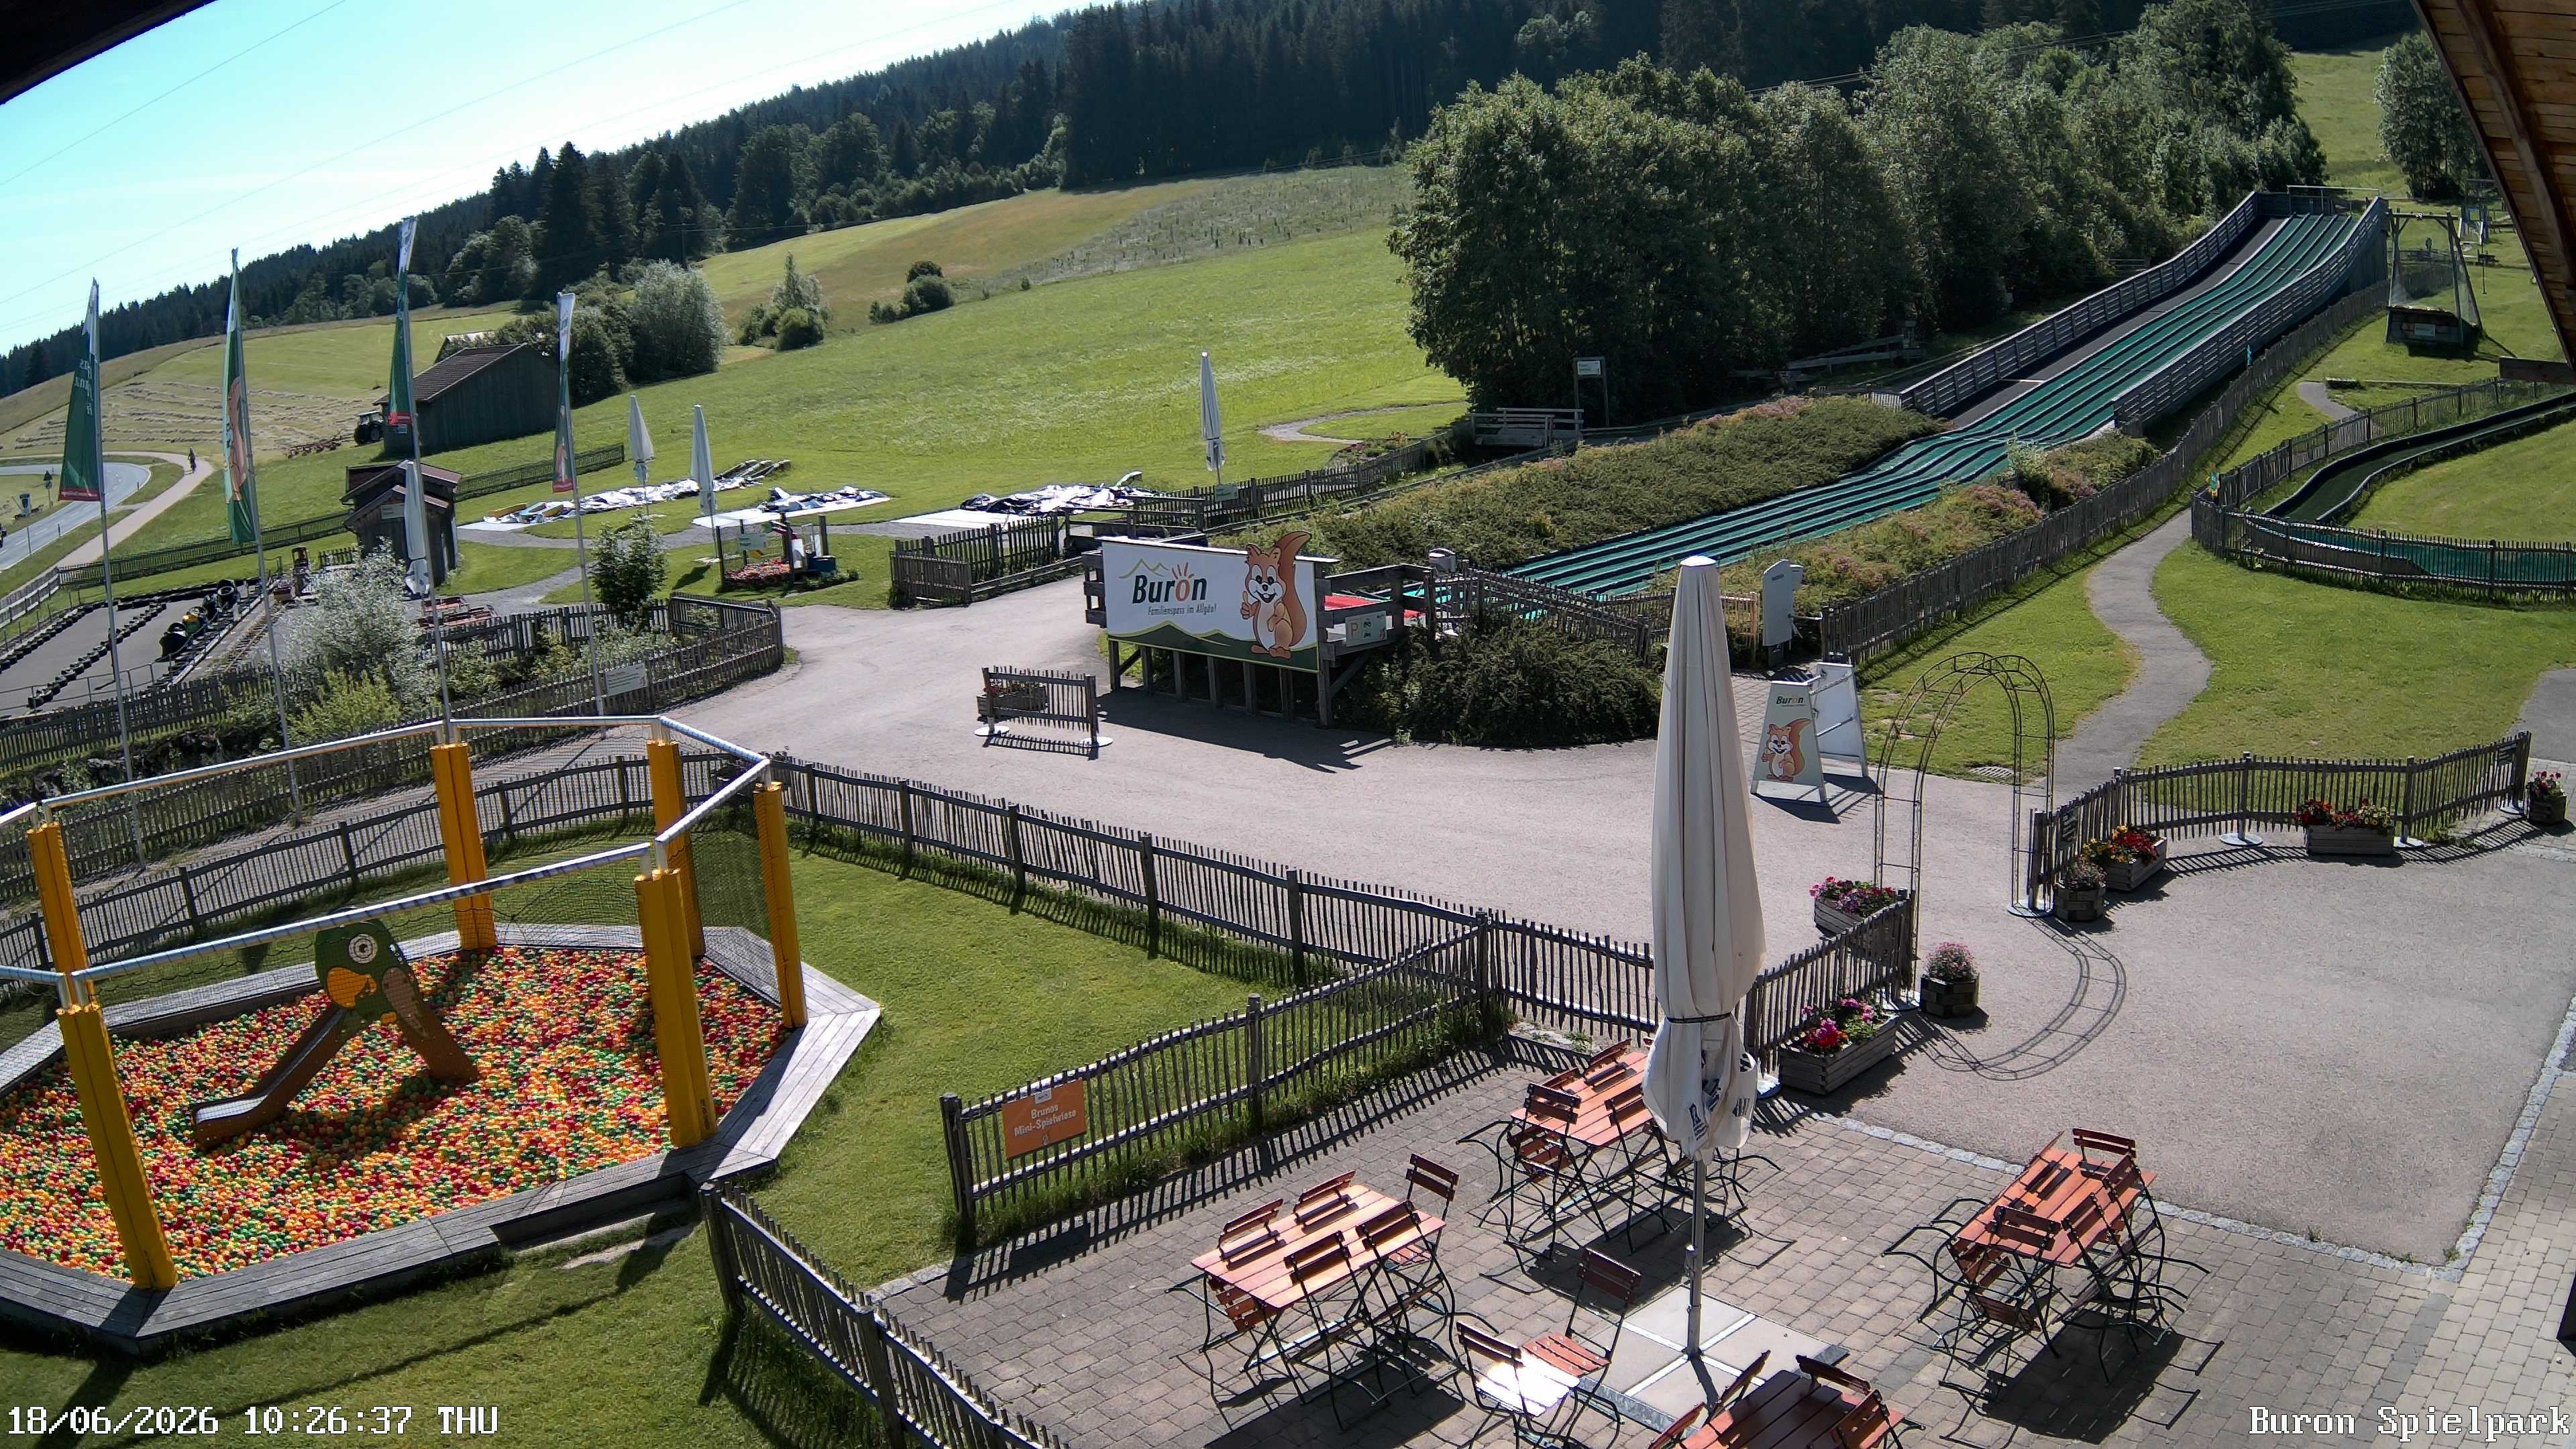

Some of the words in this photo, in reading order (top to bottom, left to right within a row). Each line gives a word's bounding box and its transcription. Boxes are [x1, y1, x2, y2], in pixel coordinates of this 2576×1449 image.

[1132, 574, 1207, 604] Buron
[1187, 606, 1194, 614] im
[1776, 696, 1804, 704] Buron
